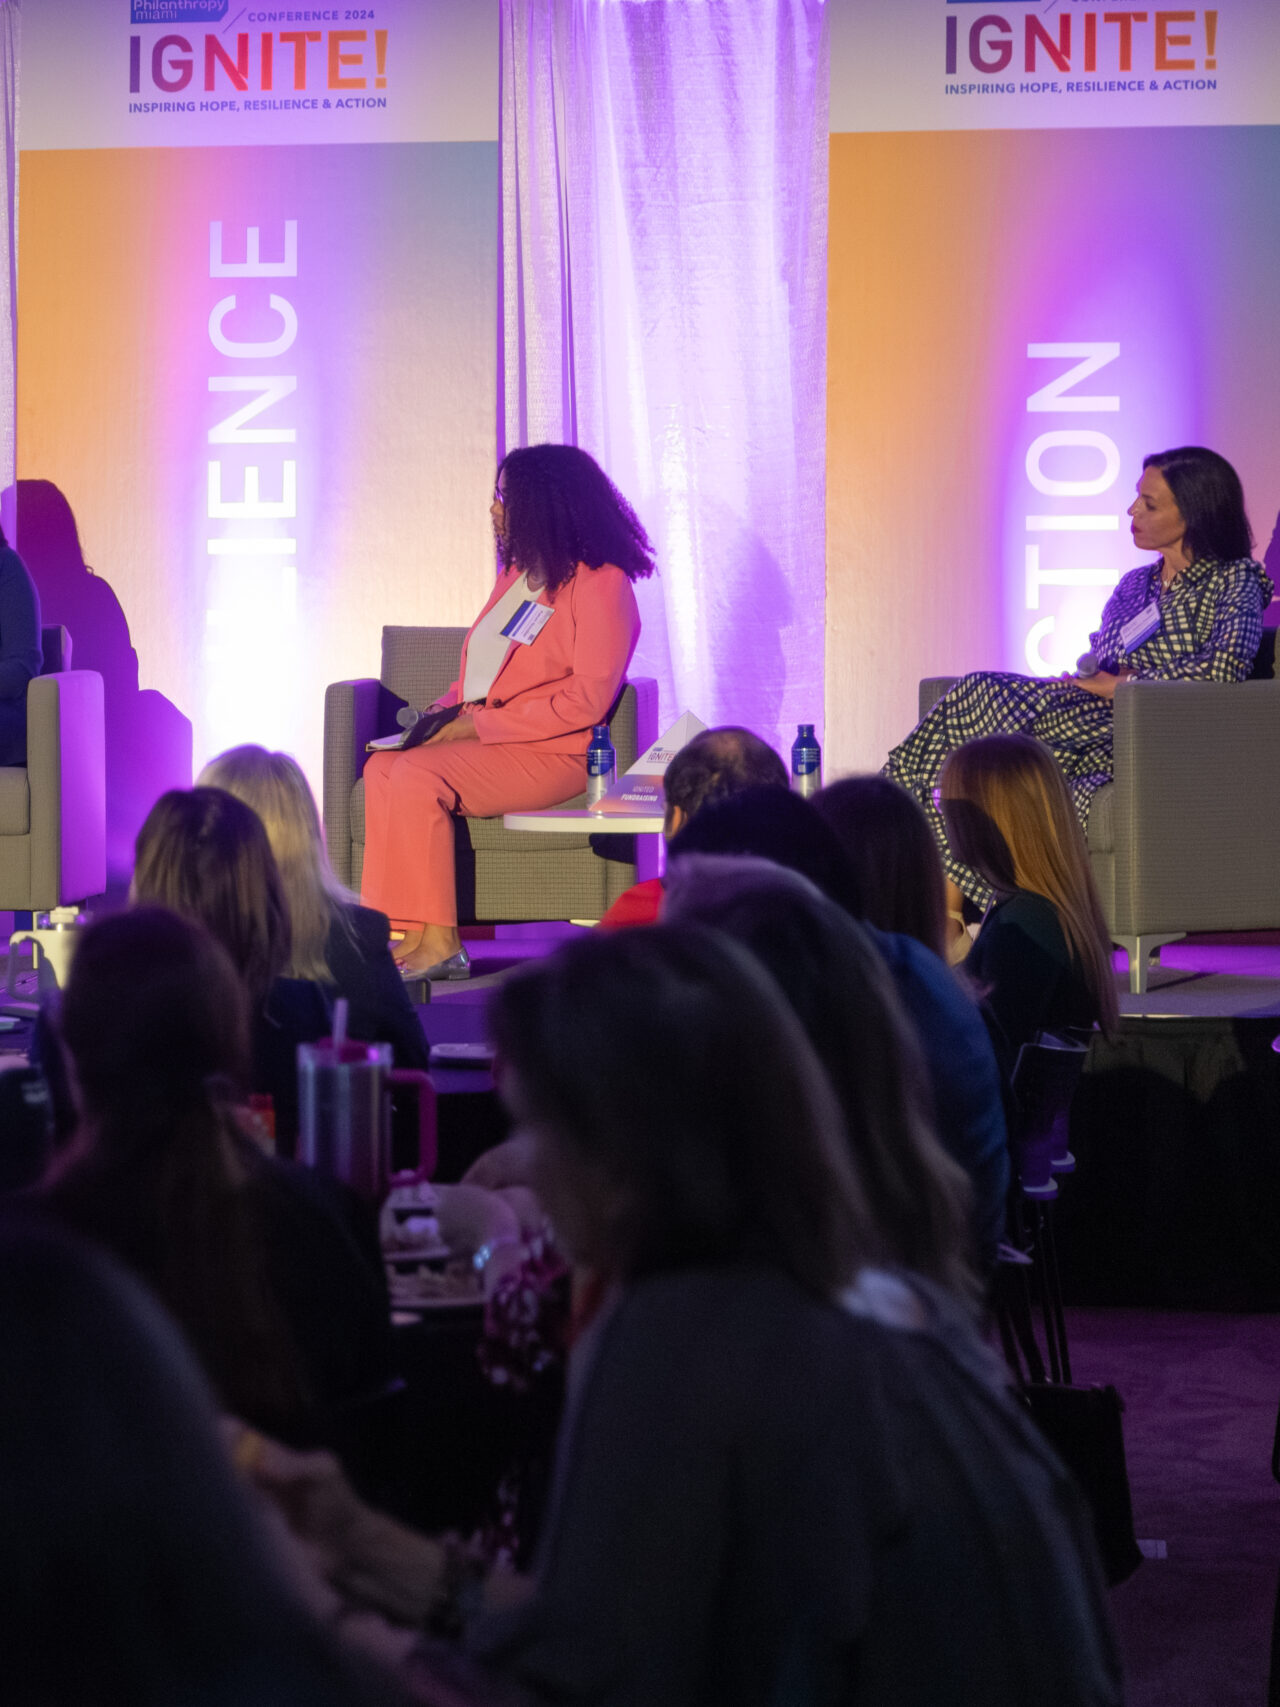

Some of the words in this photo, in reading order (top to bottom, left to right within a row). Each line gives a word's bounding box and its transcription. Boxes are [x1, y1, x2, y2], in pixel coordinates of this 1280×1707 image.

[135, 9, 177, 20] miami
[247, 11, 339, 23] CONFERENCE
[344, 10, 375, 20] 2024
[945, 10, 1218, 74] IGNITE!
[129, 29, 388, 93] IGNITE!
[945, 83, 1016, 95] INSPIRING
[1020, 82, 1063, 94] HOPE,
[1066, 80, 1145, 92] RESILIENCE
[1149, 80, 1159, 91] &
[1163, 79, 1217, 91] ACTION
[128, 101, 195, 113] INSPIRING
[199, 100, 240, 112] HOPE,
[243, 99, 318, 111] RESILIENCE
[322, 99, 332, 109] &
[335, 97, 387, 109] ACTION
